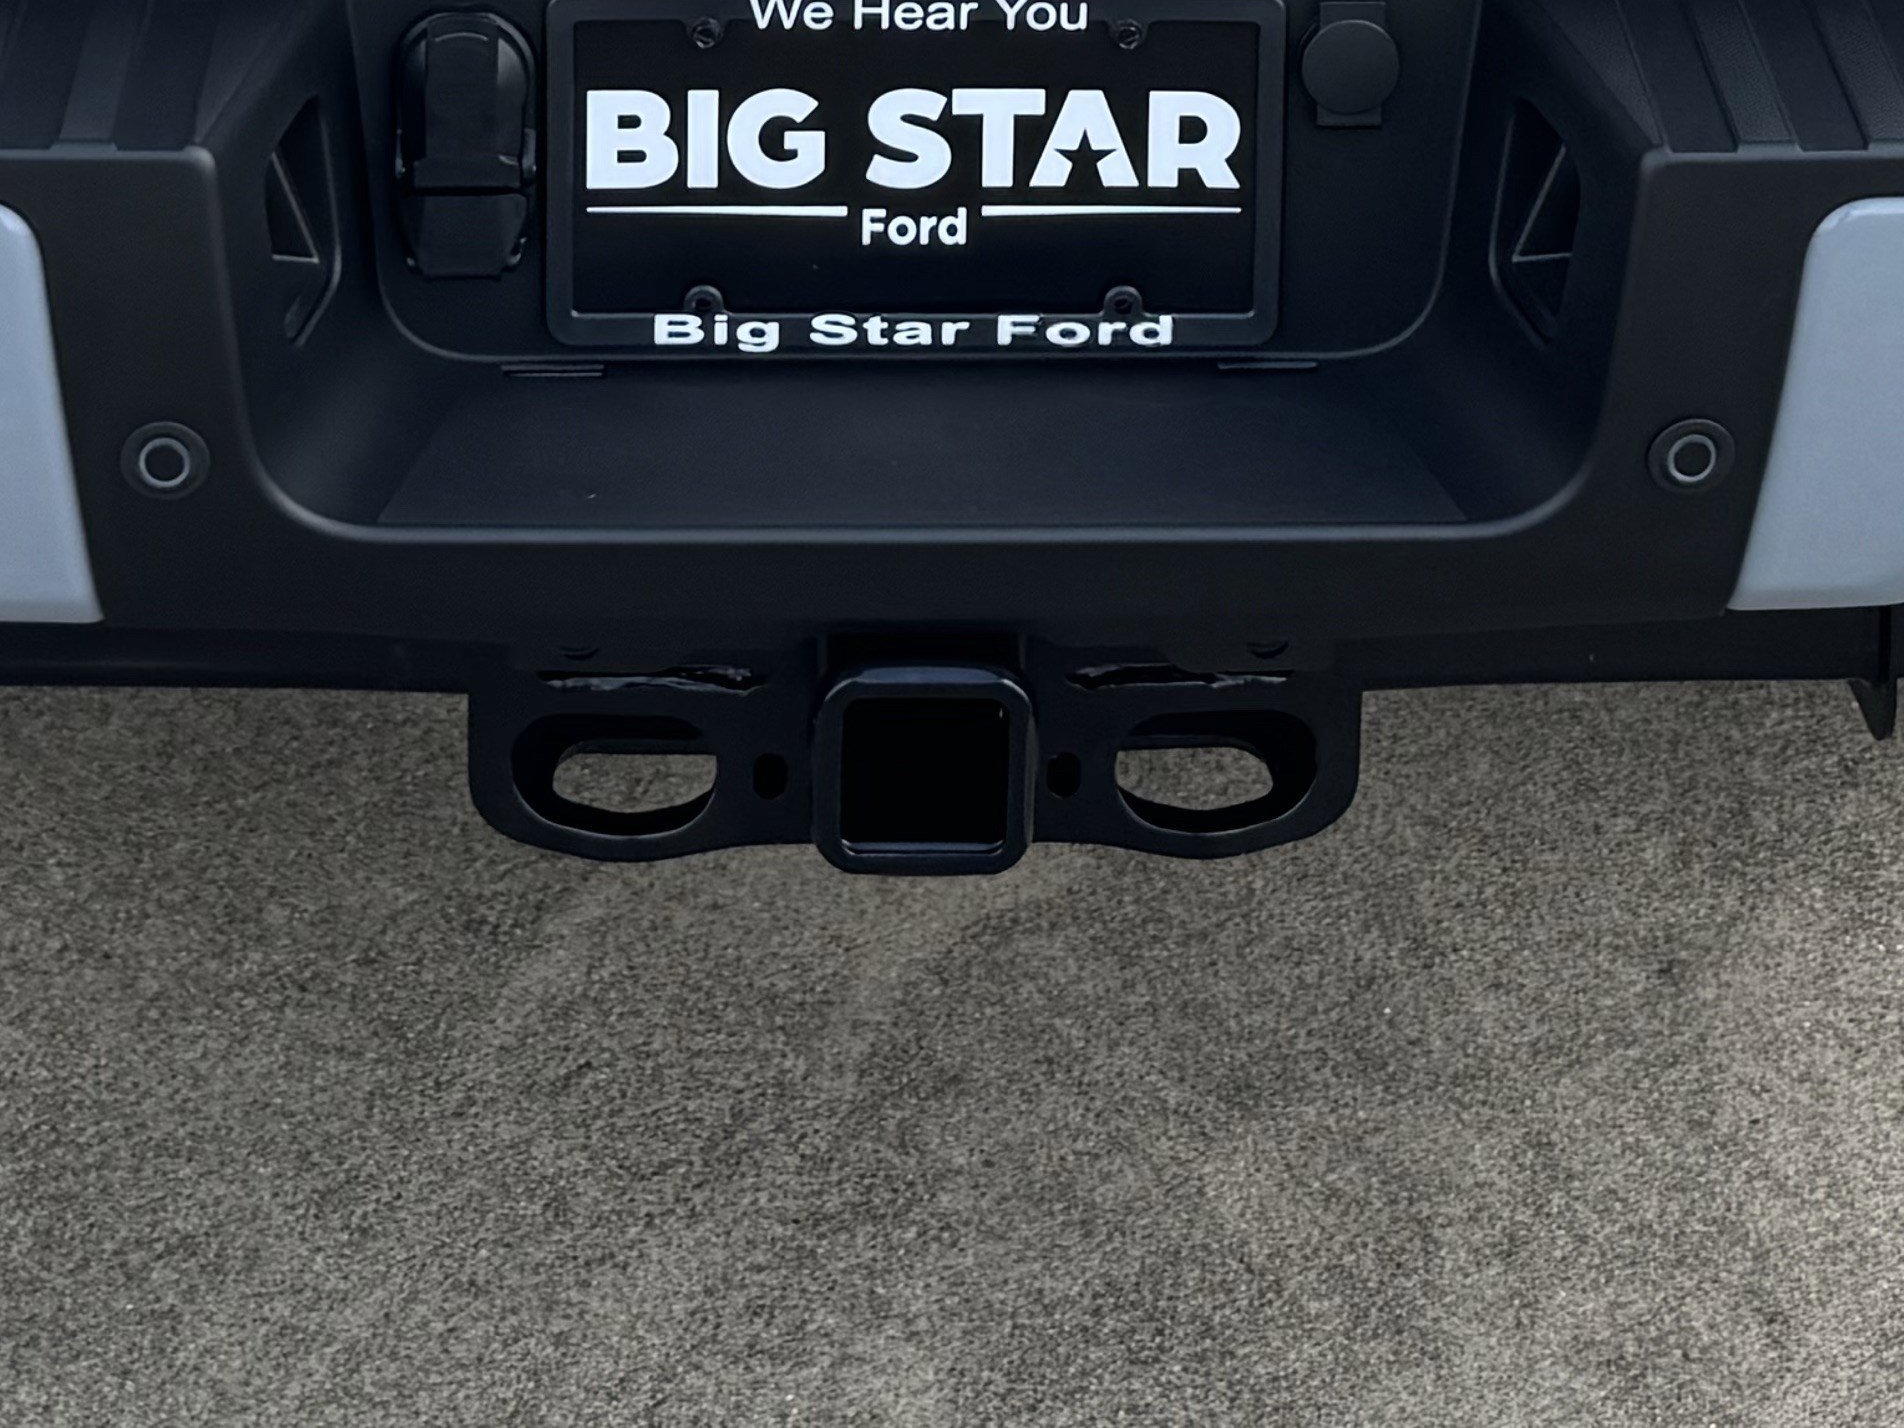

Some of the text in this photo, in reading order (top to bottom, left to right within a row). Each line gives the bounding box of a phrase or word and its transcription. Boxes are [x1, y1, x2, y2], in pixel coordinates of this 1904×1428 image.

[585, 87, 1241, 190] BIG STAR
[861, 206, 968, 246] Ford
[653, 313, 1178, 353] Big Star Ford
